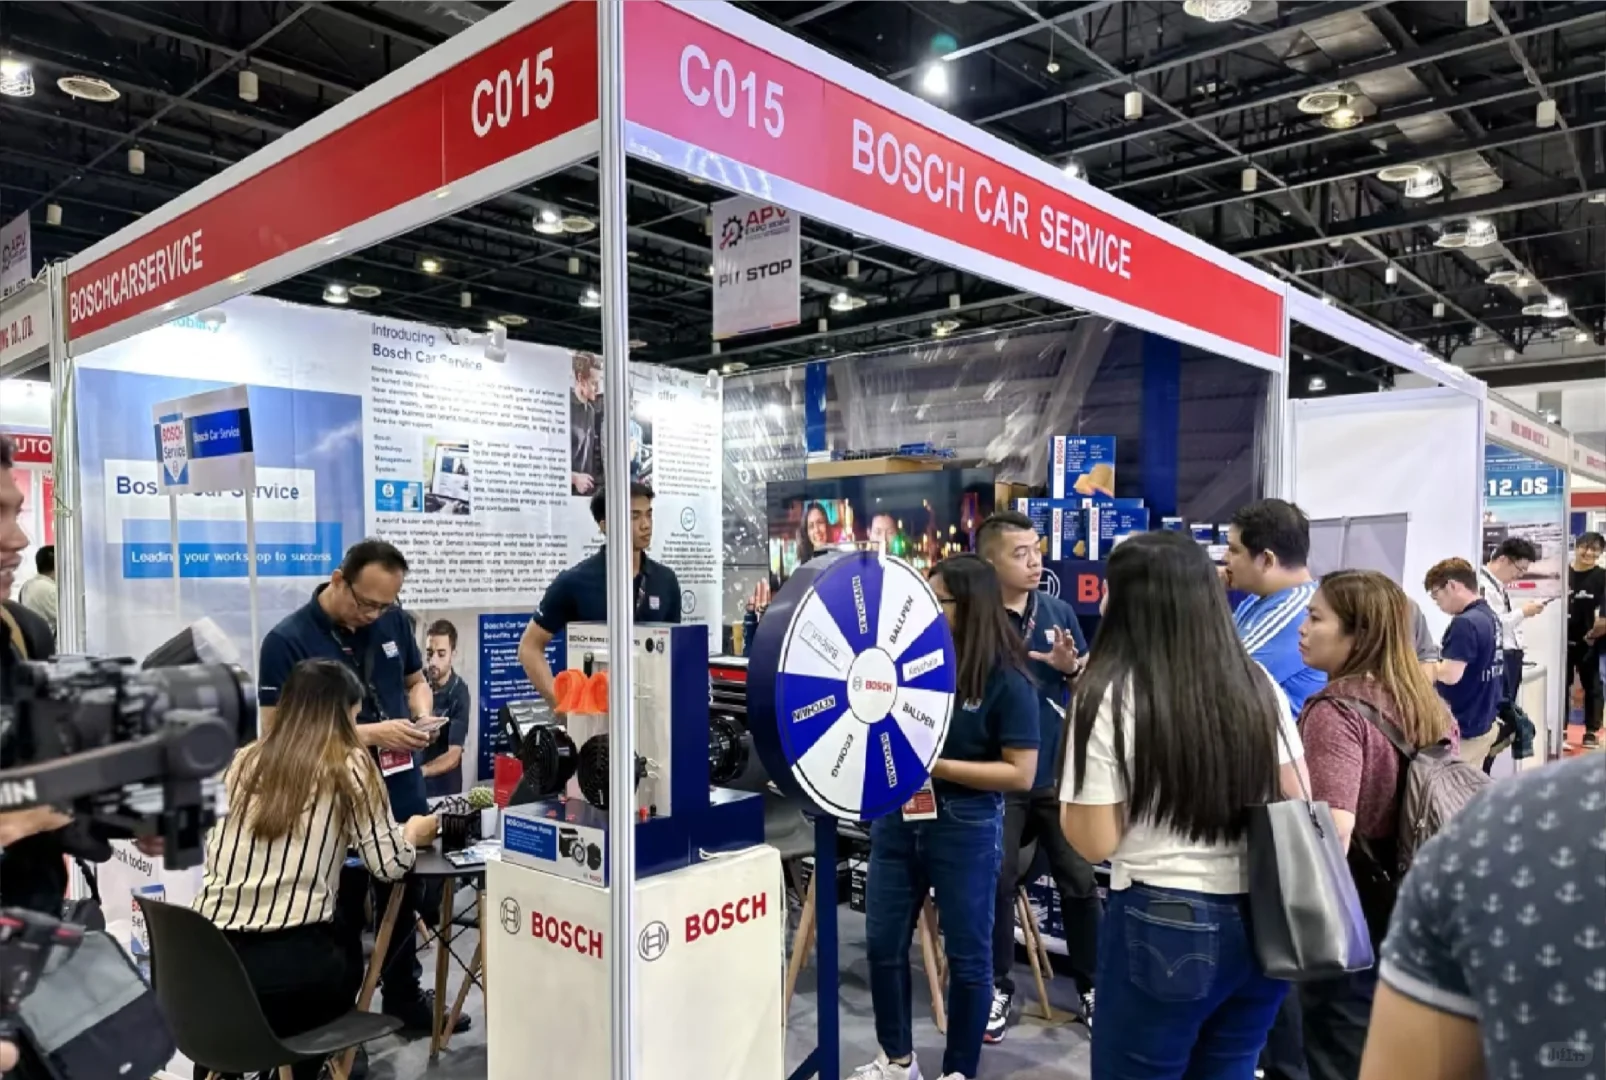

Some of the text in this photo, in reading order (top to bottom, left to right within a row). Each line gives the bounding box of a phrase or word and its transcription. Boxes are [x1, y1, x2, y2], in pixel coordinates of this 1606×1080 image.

[471, 46, 555, 138] C015
[680, 43, 785, 138] C015
[852, 118, 1132, 280] BOSCH CAR SERVICE
[746, 205, 786, 227] APV
[70, 229, 203, 323] BOSCHCARSERVICE
[747, 259, 792, 281] STOP
[372, 323, 436, 347] Introducing
[373, 343, 412, 361] Bosch
[416, 351, 436, 364] Car
[15, 437, 52, 454] UTO
[162, 425, 183, 441] BOSCH
[209, 428, 219, 440] Car
[220, 425, 240, 439] Service
[163, 446, 186, 459] Service
[1056, 439, 1064, 465] BOSCH
[1488, 477, 1548, 496] 12.0S
[131, 551, 332, 564] Leadin your worksop to success
[853, 577, 867, 633] KEYCHAIN
[889, 596, 914, 645] BALLPEN
[865, 680, 892, 692] BOSCH
[793, 696, 836, 721] KEYCHAIN
[902, 703, 936, 730] BALLPEN
[831, 733, 854, 778] ECOBAG
[880, 732, 898, 787] KEYCHAIN
[0, 779, 37, 804] IN
[129, 853, 153, 877] today
[685, 892, 767, 943] BOSCH
[531, 911, 604, 959] BOSCH
